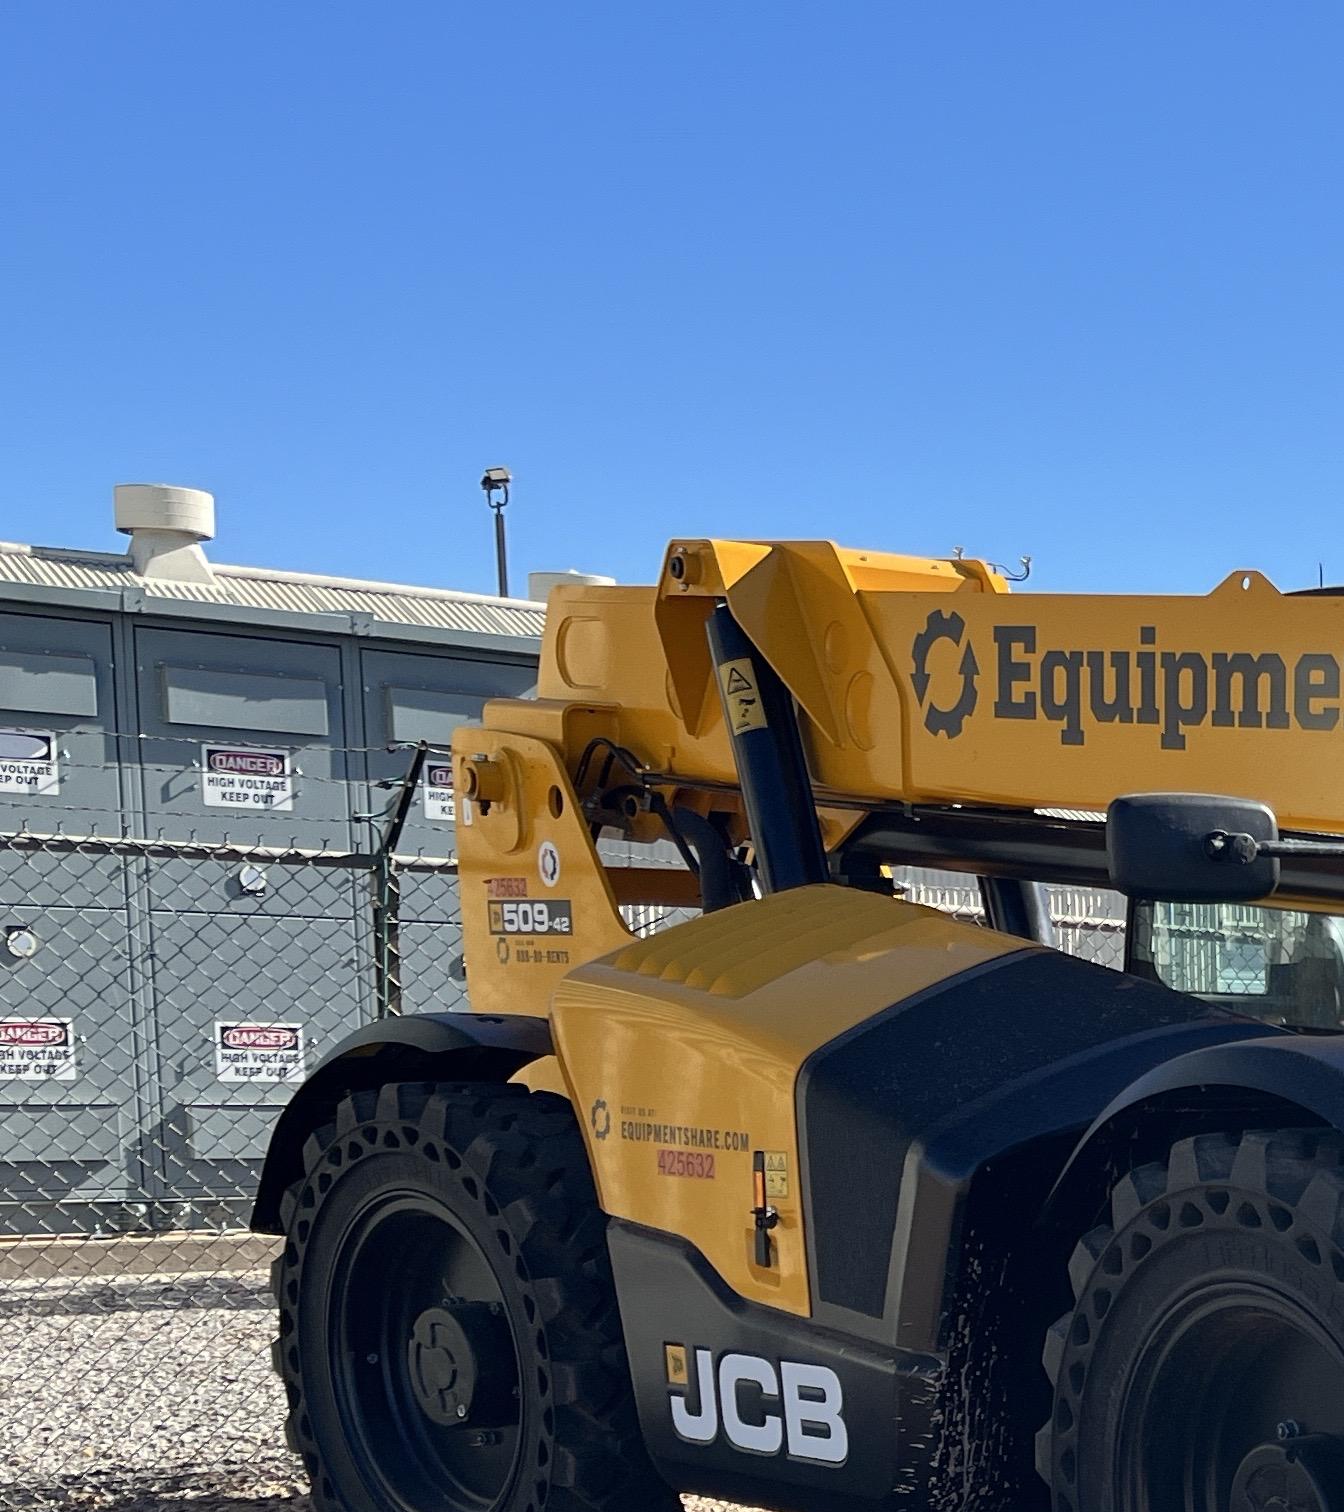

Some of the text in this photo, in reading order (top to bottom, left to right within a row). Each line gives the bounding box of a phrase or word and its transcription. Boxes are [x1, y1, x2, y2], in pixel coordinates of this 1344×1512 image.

[1, 764, 52, 776] VOLTAGE
[215, 755, 277, 772] DANGER
[16, 775, 39, 785] OUT
[207, 776, 287, 791] HIGH VOLTAGE
[220, 791, 275, 805] KEEP OUT
[441, 805, 454, 816] KE
[228, 1031, 290, 1046] DANGER
[621, 1121, 750, 1152] EQUIPMENTSHARE.COM
[658, 1150, 715, 1179] 425632
[668, 1348, 849, 1463] JCB
